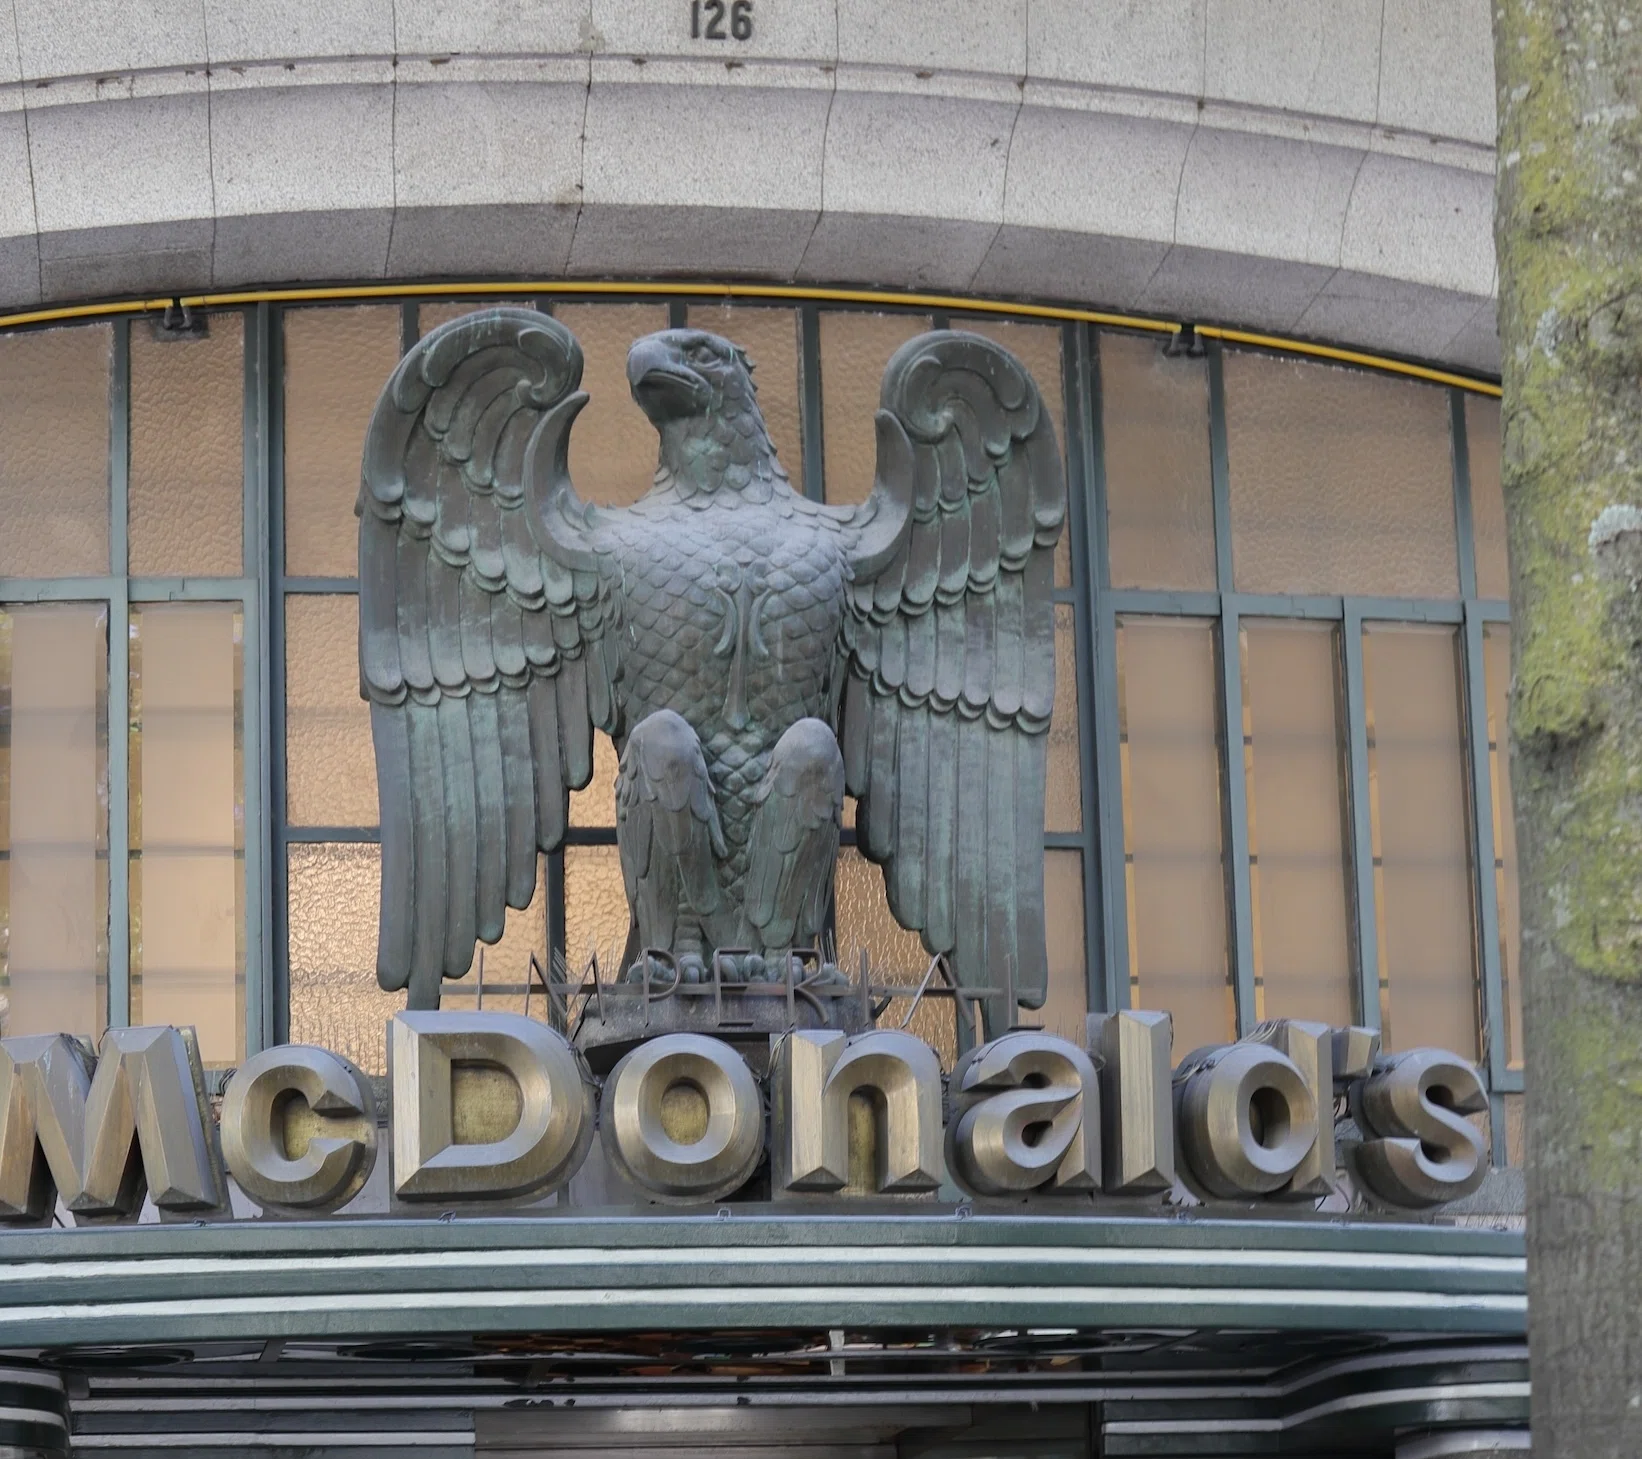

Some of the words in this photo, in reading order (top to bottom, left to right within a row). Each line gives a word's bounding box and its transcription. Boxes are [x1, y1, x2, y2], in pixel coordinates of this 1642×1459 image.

[691, 0, 752, 40] 126
[477, 946, 1044, 1030] IMPERIAL
[0, 1010, 1490, 1220] McDonald's
